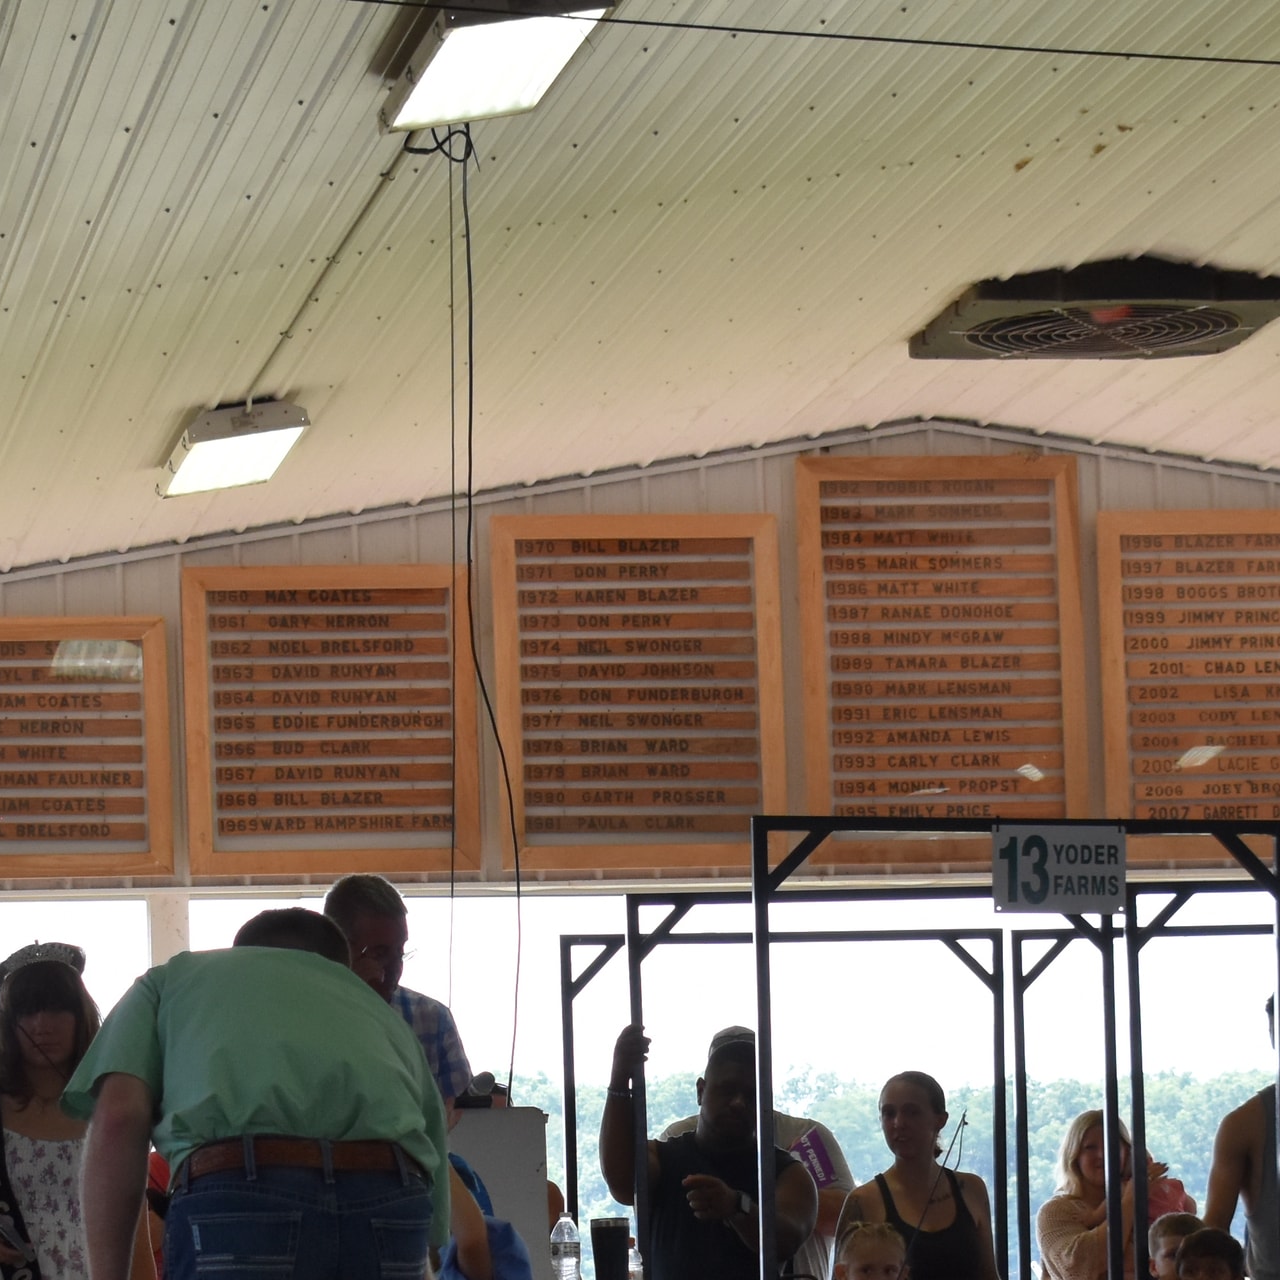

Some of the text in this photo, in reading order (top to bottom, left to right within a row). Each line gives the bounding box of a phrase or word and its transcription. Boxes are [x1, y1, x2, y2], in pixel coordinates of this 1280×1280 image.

[828, 556, 1004, 570] 1985 MARK SOMMERS
[1126, 561, 1163, 574] 1997
[1175, 561, 1235, 573] BLAZER
[521, 588, 699, 604] 1972 KAREN BLAZER
[1128, 586, 1164, 599] 1998
[1176, 586, 1228, 599] BOGGS
[832, 605, 1014, 620] 1987 RANAE DONOHOE
[1128, 611, 1166, 624] 1999
[1177, 610, 1225, 624] JIMMY
[522, 614, 673, 628] 1973 DON PERRY
[214, 640, 415, 654] 1962 NOEL BRELSFORD
[522, 640, 703, 654] 1974 NEIL SWONGER
[1129, 637, 1170, 649] 2000
[1185, 637, 1234, 649] JIMMY
[835, 655, 1022, 670] 1989 TAMARA BLAZER
[1149, 662, 1184, 675] 2001
[1204, 661, 1246, 674] CHAD
[1138, 688, 1180, 699] 2002
[1213, 686, 1251, 699] LISA
[37, 695, 102, 707] COATES
[524, 713, 704, 728] 1977 NEIL SWONGER
[837, 706, 1004, 721] 1991 ERIC LENSMAN
[216, 714, 444, 730] 1965 EDDIE FUNDERBURGH
[838, 729, 1011, 744] 1992 AMANDA LEWIS
[17, 746, 68, 760] WHITE
[839, 754, 1001, 768] 1993 CARLY CLARK
[48, 771, 132, 785] FAULKNER
[218, 765, 400, 781] 1967 DAVID RUNYAN
[582, 765, 629, 778] BRIAN
[646, 764, 691, 778] WARD
[218, 791, 384, 807] 1968 BILL BLAZER
[16, 823, 111, 837] BRELSFORD
[1052, 844, 1119, 865] YODER
[998, 834, 1050, 905] 13
[1053, 875, 1119, 896] FARMS
